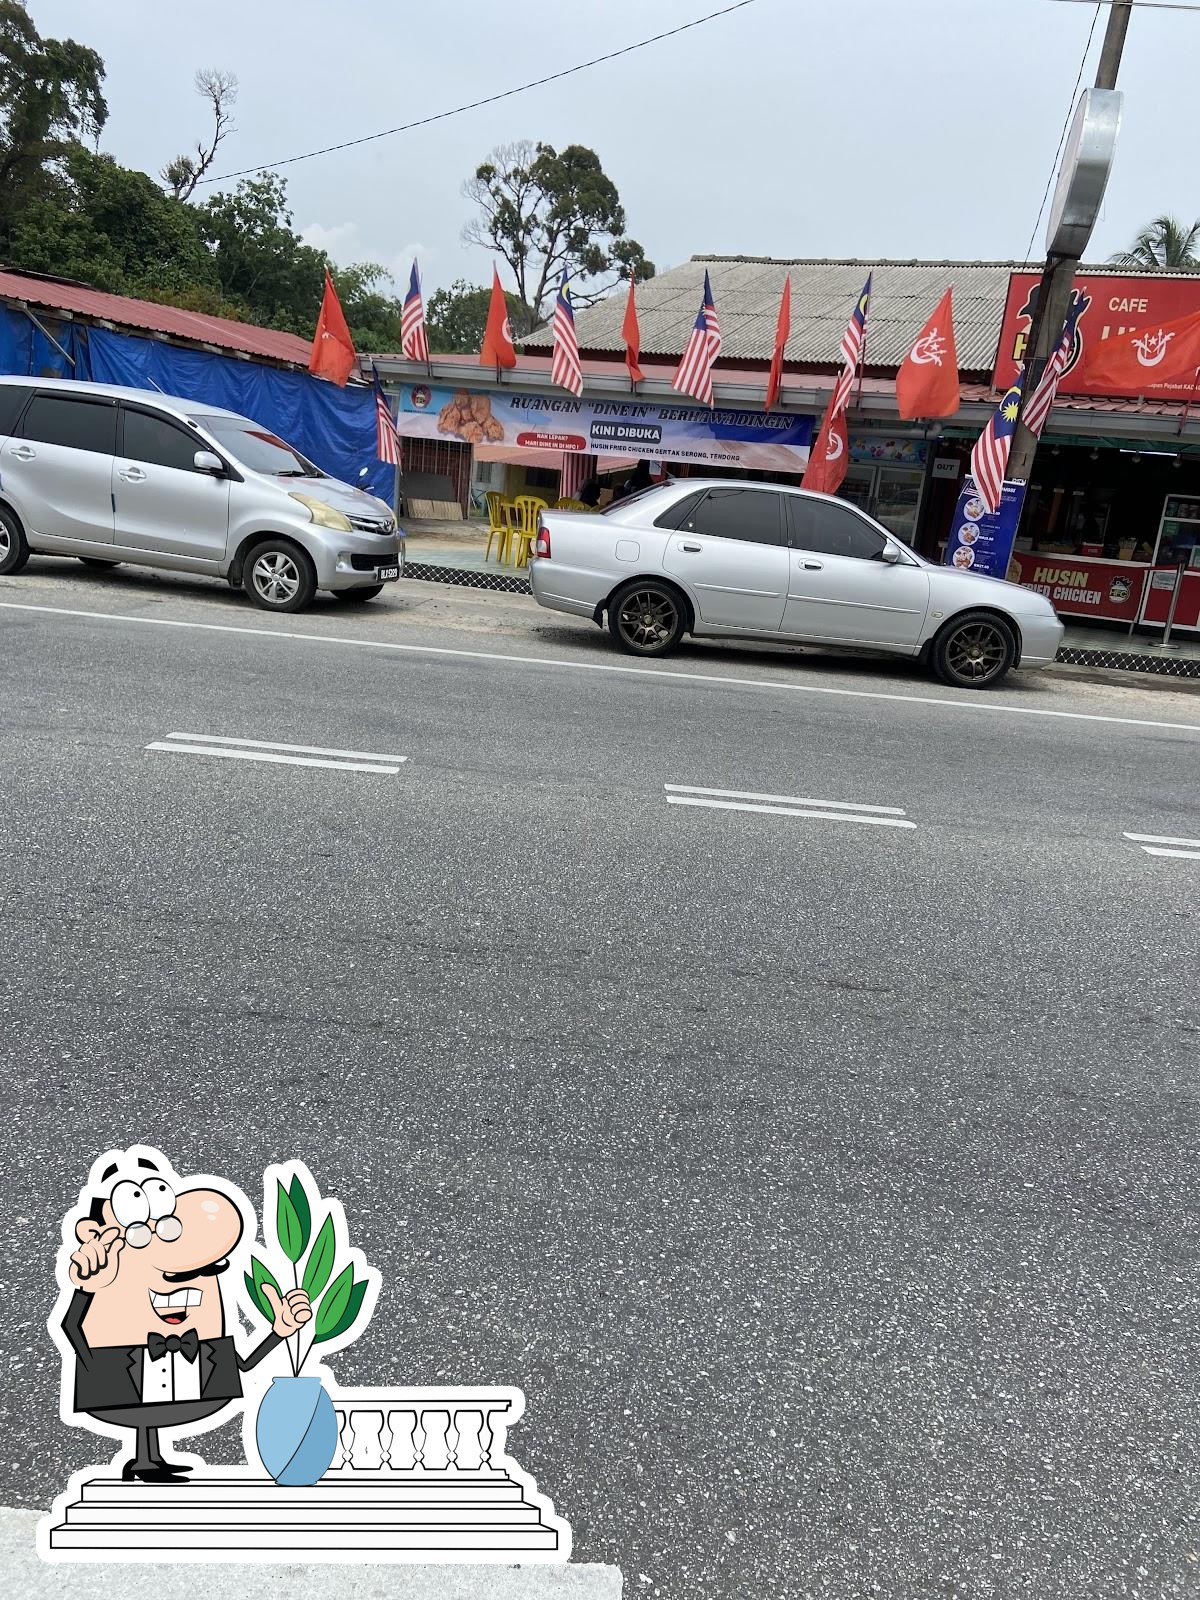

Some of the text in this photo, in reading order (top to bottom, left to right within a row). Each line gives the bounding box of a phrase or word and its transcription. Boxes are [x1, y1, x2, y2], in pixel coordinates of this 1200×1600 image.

[1108, 297, 1149, 313] CAFE
[510, 396, 582, 413] RUANGAN
[591, 424, 661, 440] KINI DIBUKA
[590, 442, 740, 461] HUSIN FRIED CHICKEN GERTAK SERONG, TENDONG
[936, 463, 955, 471] OUT
[1033, 566, 1089, 588] HUSIN
[1052, 586, 1102, 605] CHICKEN
[1109, 588, 1128, 599] HFC
